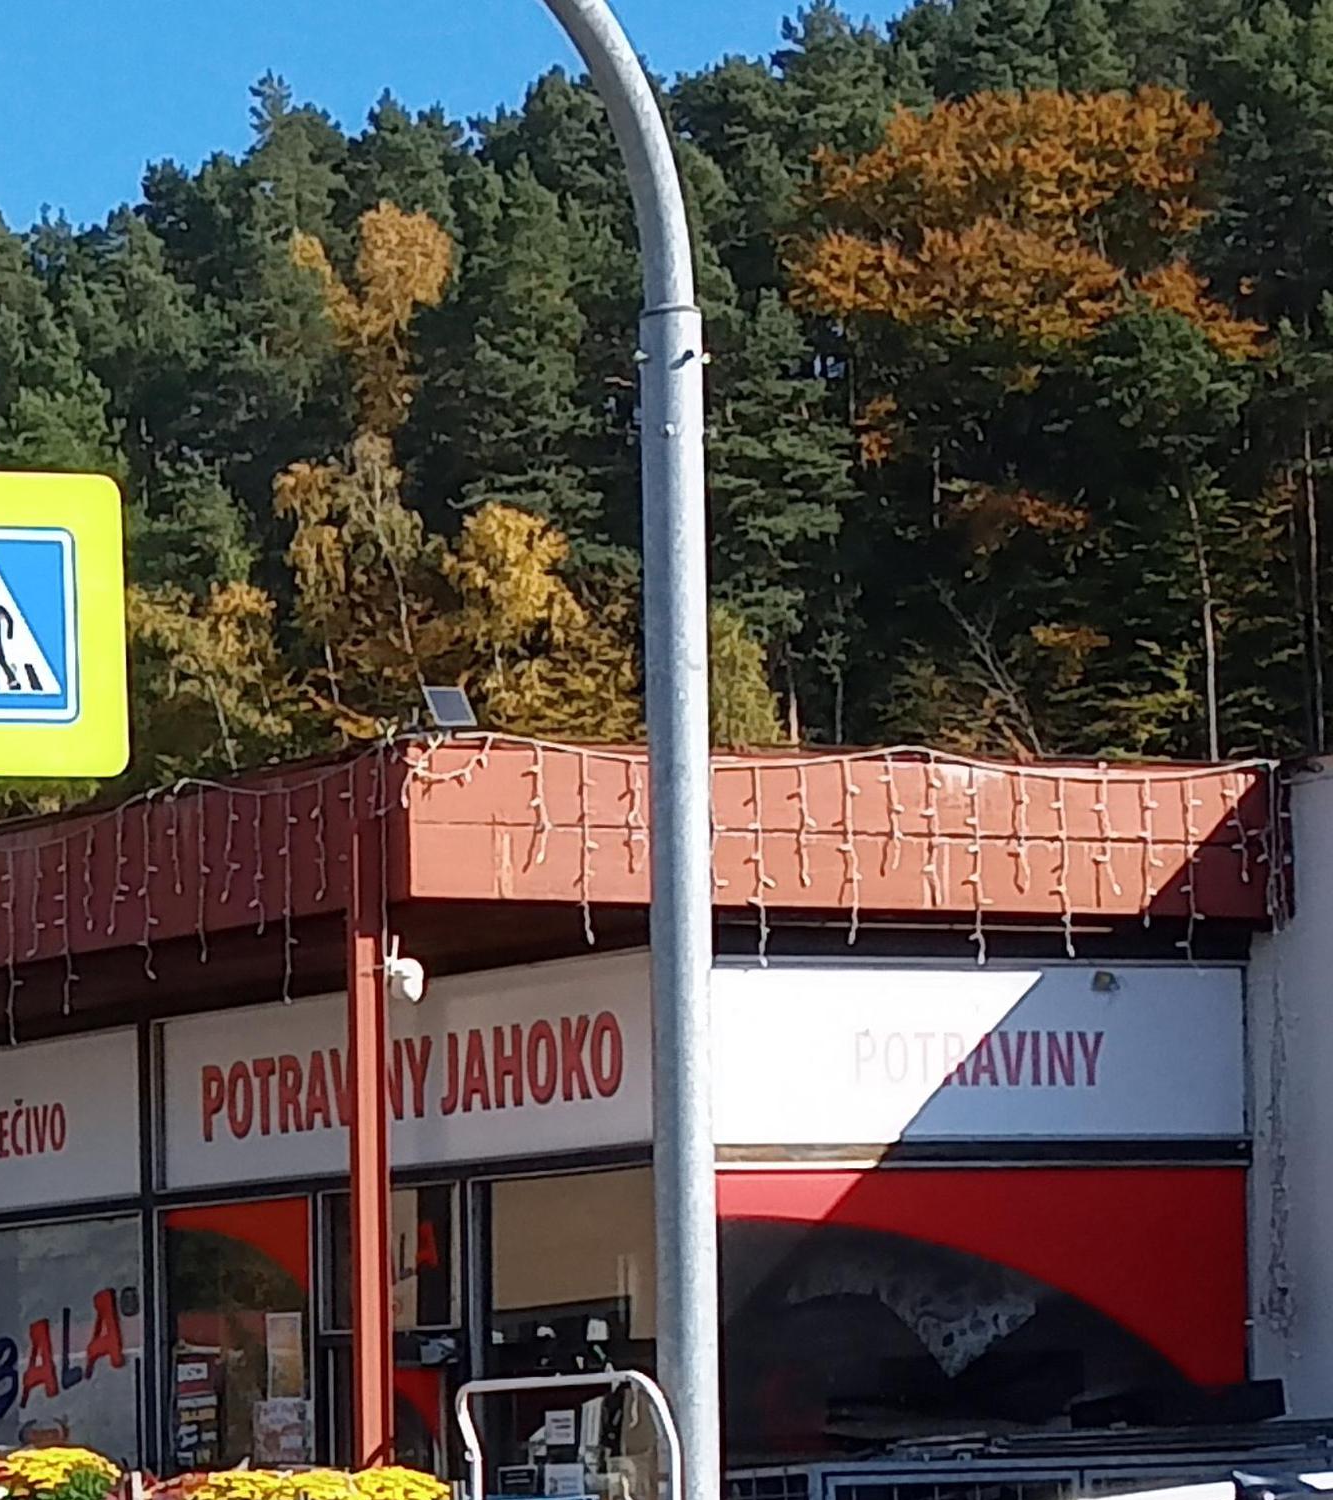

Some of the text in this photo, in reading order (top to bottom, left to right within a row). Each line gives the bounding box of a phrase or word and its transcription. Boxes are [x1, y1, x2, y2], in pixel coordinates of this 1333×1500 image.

[201, 1010, 624, 1142] POTRAVNY JAHOKO
[854, 1030, 1106, 1087] POTRAVINY
